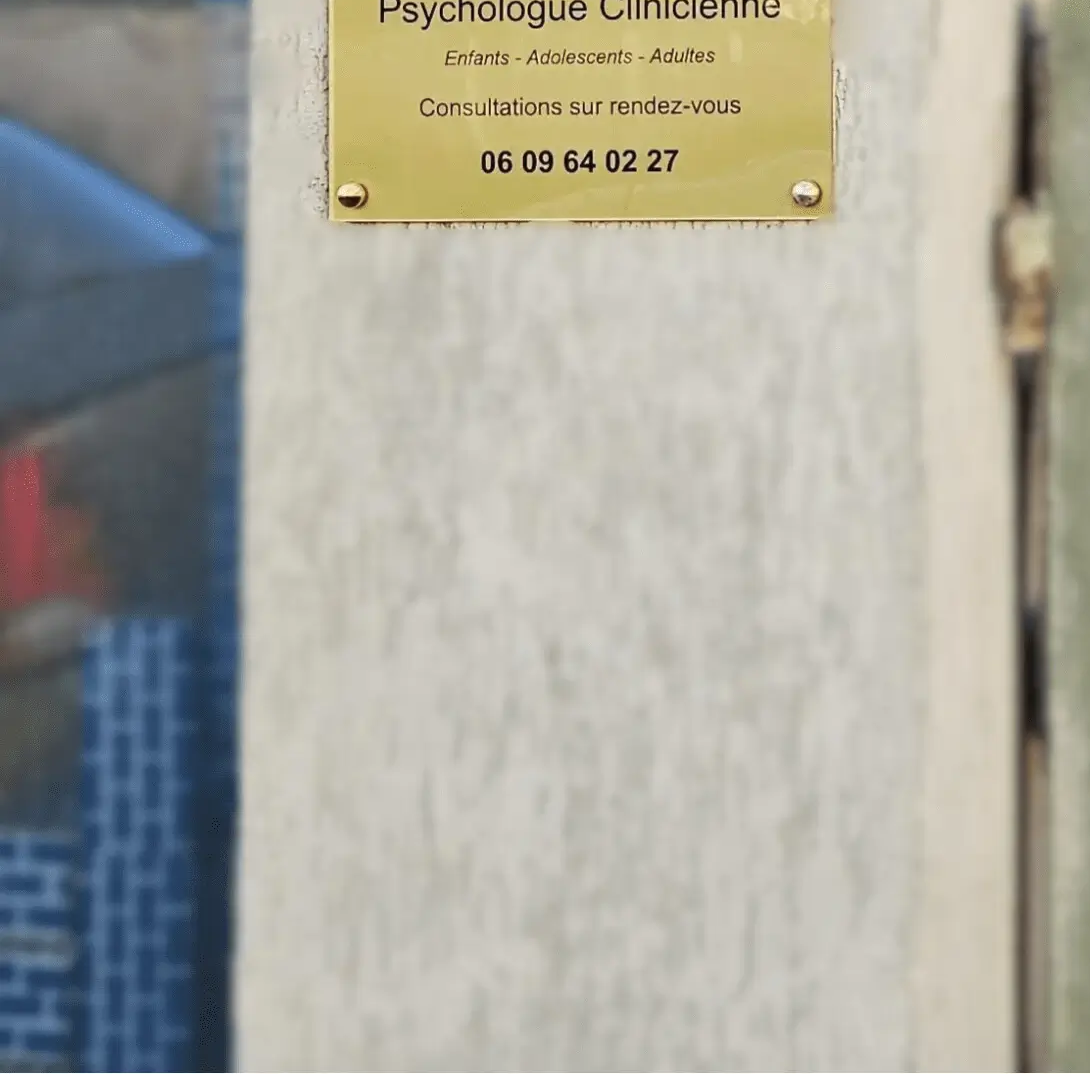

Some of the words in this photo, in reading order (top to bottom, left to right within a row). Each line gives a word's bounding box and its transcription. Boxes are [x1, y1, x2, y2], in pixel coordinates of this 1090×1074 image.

[444, 49, 510, 66] Enfants
[526, 48, 633, 65] Adolescents
[649, 47, 716, 64] Adultes
[419, 97, 562, 118] Consultations
[569, 100, 603, 116] sur
[610, 95, 742, 116] rendez-vous
[481, 150, 513, 174] 06
[522, 149, 554, 174] 09
[563, 149, 597, 174] 64
[605, 149, 638, 173] 02
[646, 149, 679, 173] 27
